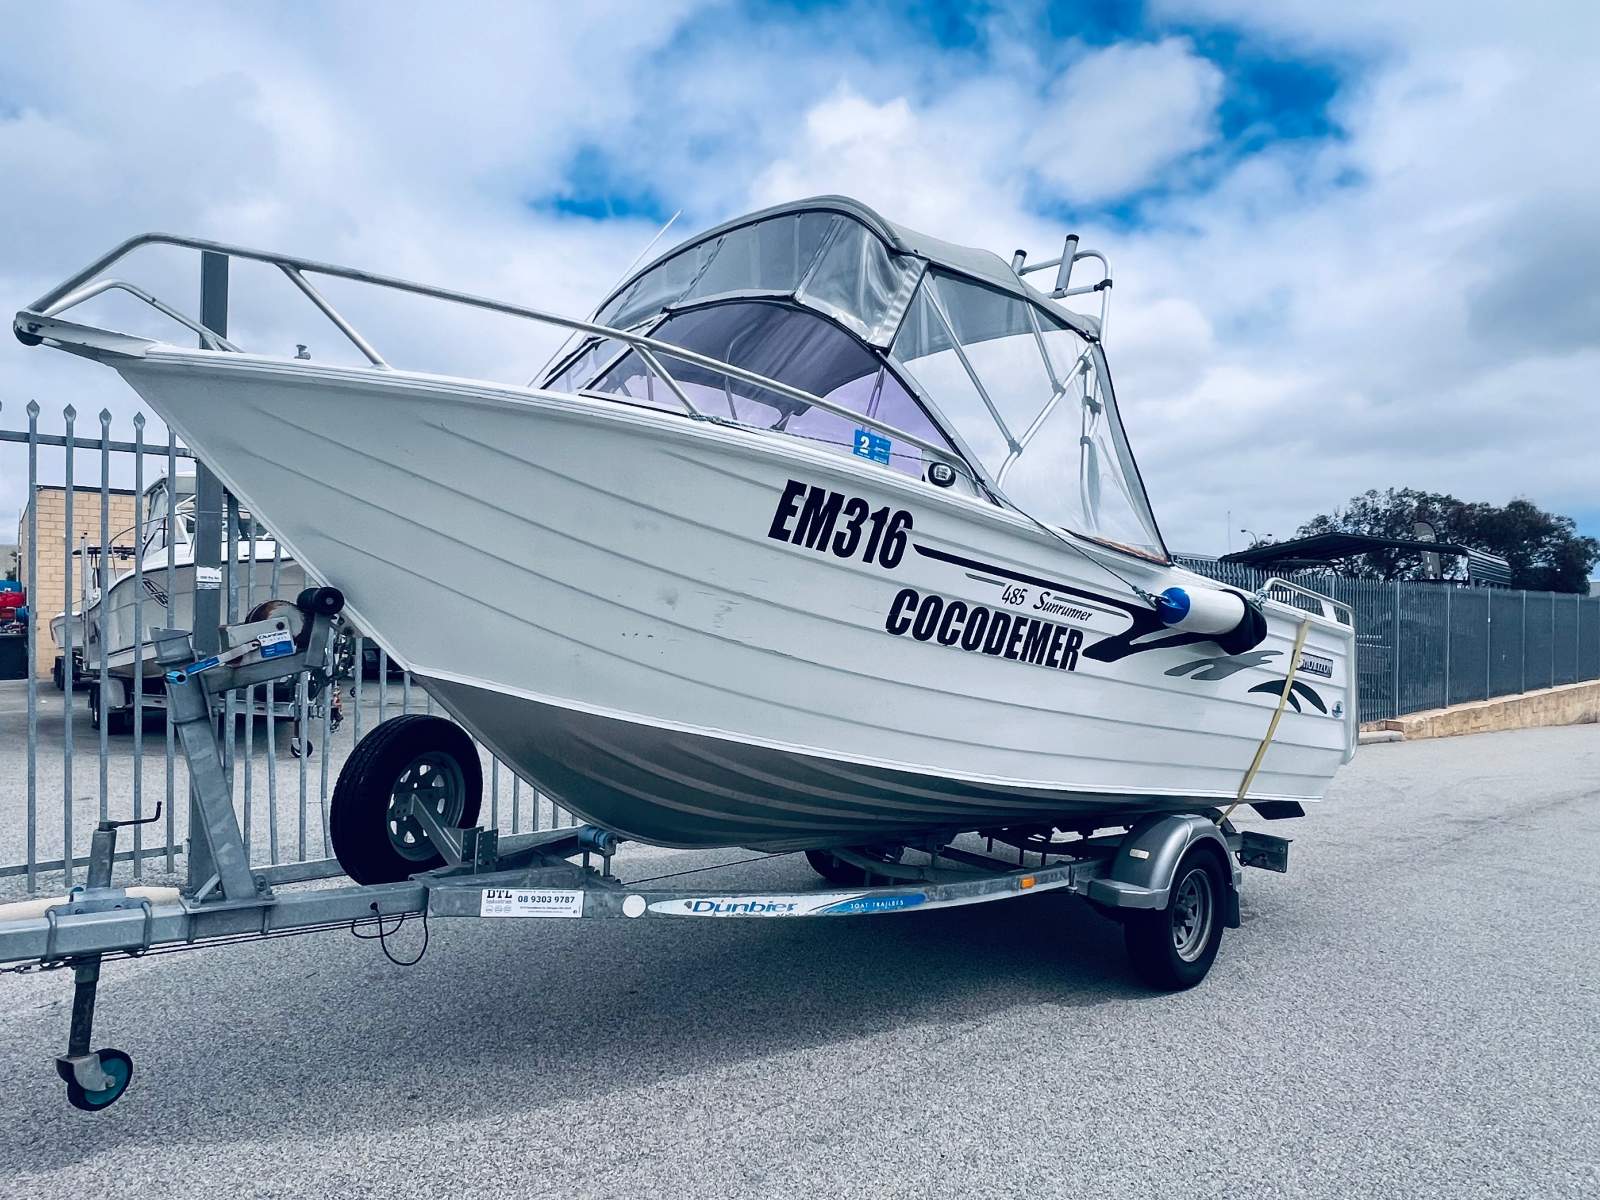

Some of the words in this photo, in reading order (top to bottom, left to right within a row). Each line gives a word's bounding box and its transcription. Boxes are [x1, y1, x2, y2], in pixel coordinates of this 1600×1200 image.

[860, 435, 870, 454] 2
[767, 479, 913, 569] EM316
[1002, 584, 1028, 606] 485
[1033, 591, 1093, 621] Sunrunner
[885, 588, 1084, 672] COCODEMER
[486, 889, 513, 899] DTL
[517, 895, 529, 903] 08
[530, 895, 552, 903] 9303
[554, 896, 576, 904] 9787
[692, 900, 798, 913] Dunbier
